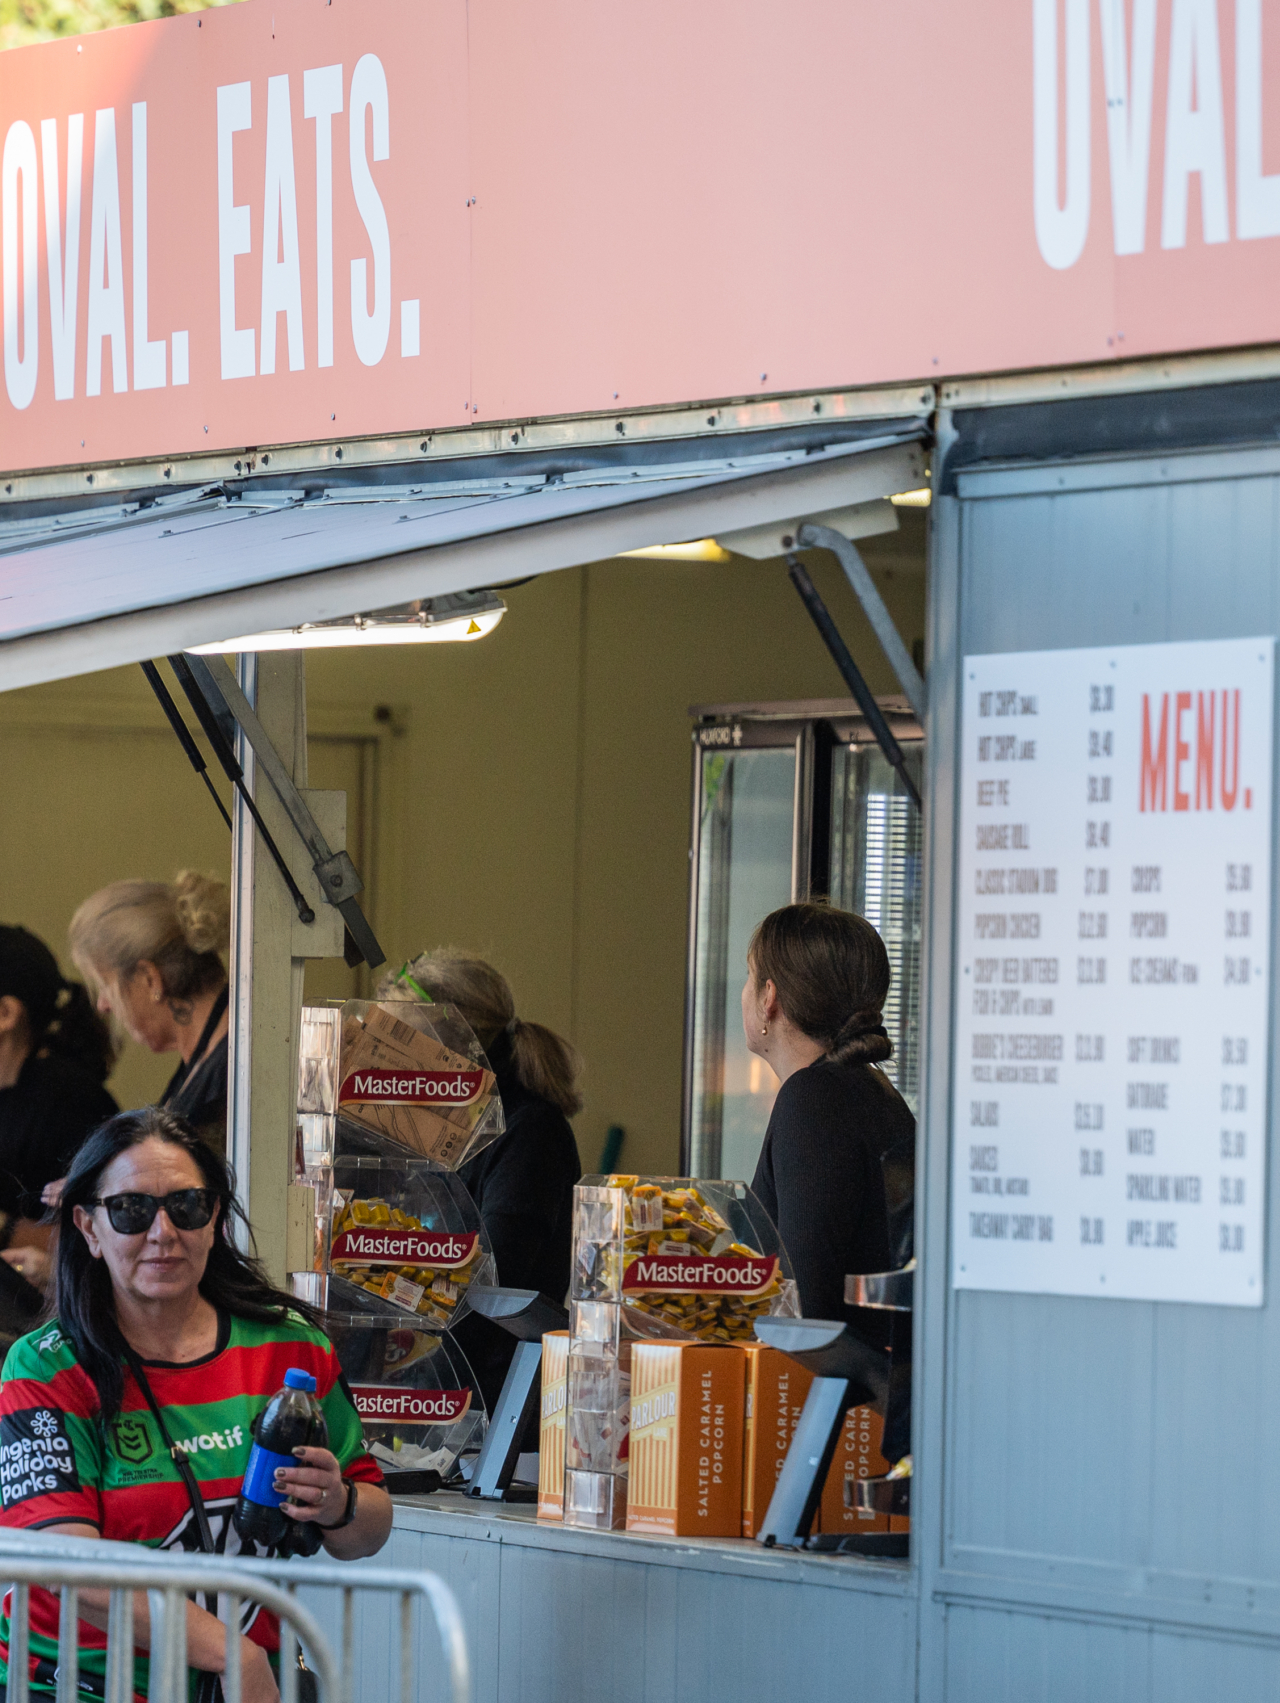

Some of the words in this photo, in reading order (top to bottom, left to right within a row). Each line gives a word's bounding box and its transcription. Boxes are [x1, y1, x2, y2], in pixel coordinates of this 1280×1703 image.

[2, 100, 190, 410] OVAL.
[217, 53, 420, 380] EATS.
[1139, 688, 1253, 813] MENU.
[175, 1425, 243, 1454] wotif
[631, 1391, 676, 1431] PARLOUR
[700, 1370, 712, 1448] CARAMEL
[0, 1436, 69, 1464] Ingenia
[0, 1452, 73, 1485] Holiday
[713, 1404, 725, 1484] POPCORN
[859, 1408, 870, 1477] OPCORN
[1, 1472, 58, 1506] Parks
[698, 1456, 710, 1517] SALTED
